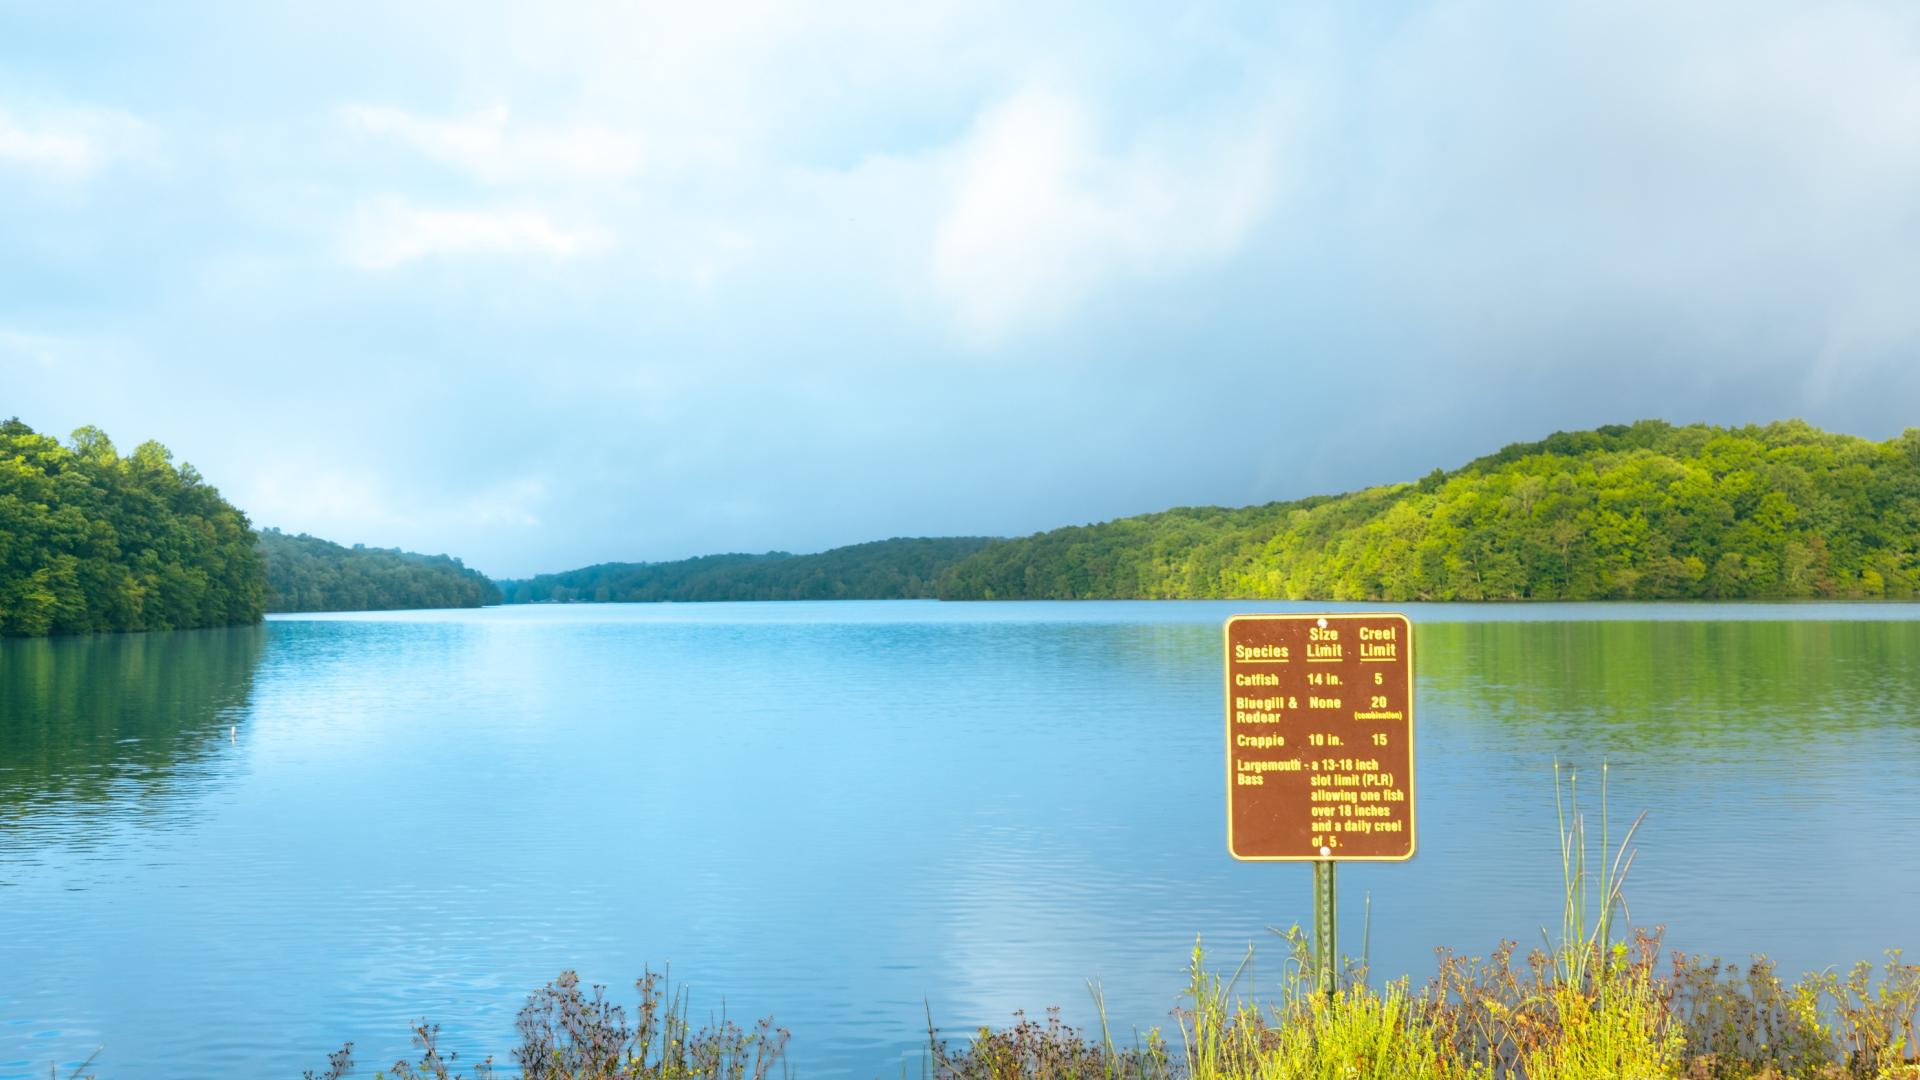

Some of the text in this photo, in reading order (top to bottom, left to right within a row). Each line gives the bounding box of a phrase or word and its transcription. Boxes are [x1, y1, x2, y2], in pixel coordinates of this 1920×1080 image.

[1310, 627, 1338, 640] Size
[1360, 627, 1395, 640] Creel
[1236, 646, 1289, 660] Species
[1307, 644, 1342, 657] Limit
[1360, 644, 1396, 657] Limit
[1236, 674, 1278, 686] Catfish
[1307, 674, 1343, 685] 14 in.
[1375, 673, 1382, 685] 5
[1236, 697, 1297, 711] Bluegill &
[1310, 697, 1341, 709] None
[1371, 697, 1387, 708] 20
[1237, 711, 1280, 723] Redear
[1354, 711, 1402, 721] (combination)
[1237, 734, 1284, 749] Crappie
[1309, 734, 1344, 746] 10 in.
[1372, 734, 1387, 745] 15
[1237, 759, 1300, 773] Largemouth
[1312, 762, 1317, 770] a
[1322, 759, 1352, 771] 13-18
[1356, 759, 1378, 770] inch
[1238, 774, 1263, 785] Bass
[1311, 774, 1393, 786] slot limit (PLR)
[1311, 790, 1403, 803] allowing one fish
[1312, 805, 1390, 816] over 18 inches
[1312, 820, 1402, 834] and a daily creel
[1312, 836, 1323, 847] of
